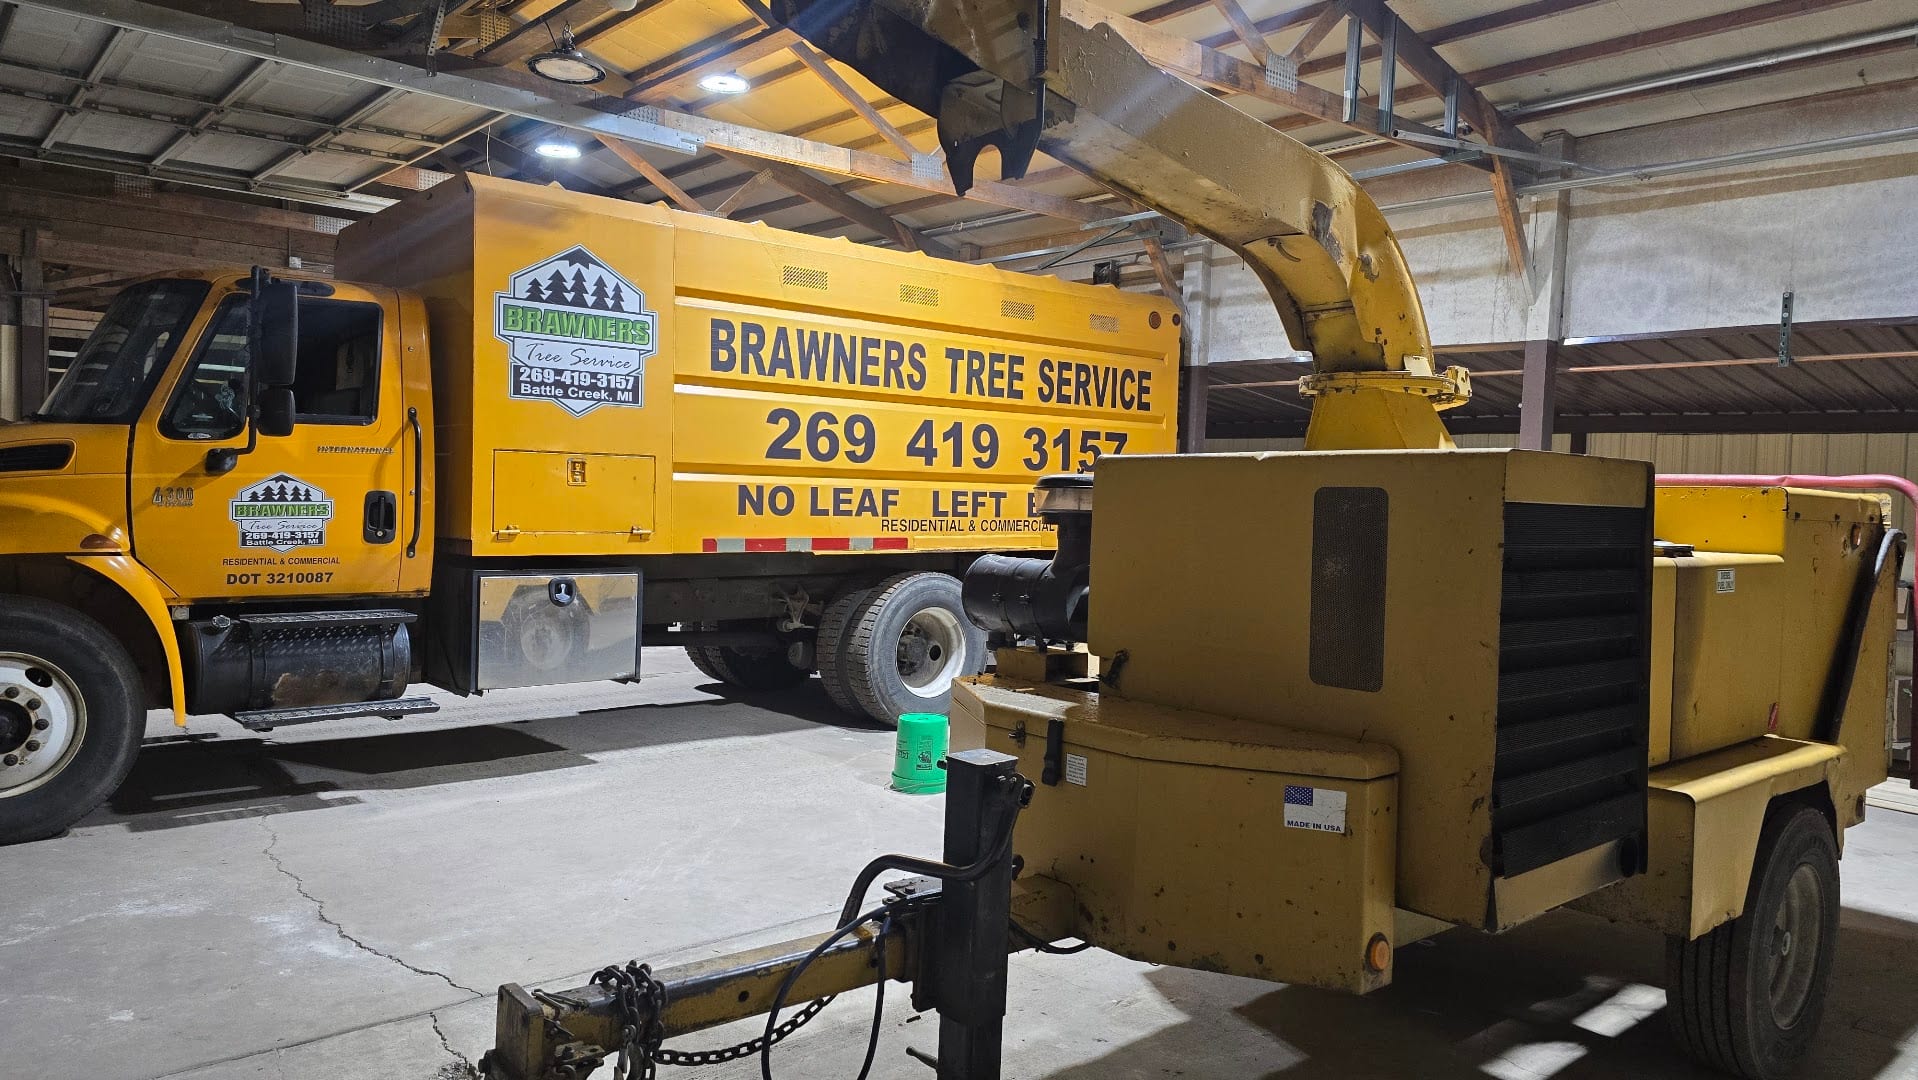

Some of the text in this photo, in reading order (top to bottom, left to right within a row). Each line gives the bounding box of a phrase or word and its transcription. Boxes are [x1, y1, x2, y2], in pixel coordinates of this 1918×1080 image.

[503, 304, 650, 346] BRAWNERS
[526, 343, 632, 369] Tree Service
[711, 318, 1152, 412] BRAWNERS TREE SERVICE
[519, 367, 634, 390] 269-419-3157
[520, 383, 633, 402] Battle Creek, MI
[765, 408, 876, 463] 269
[906, 419, 999, 470] 419
[317, 446, 393, 454] INTERNATIONAL
[152, 487, 194, 504] 4300
[738, 484, 795, 516] NO
[810, 487, 900, 517] LEAF
[932, 490, 1007, 518] LEFT
[235, 504, 329, 517] BRAWNERS
[249, 520, 318, 530] Tree Service
[881, 519, 1055, 532] RESIDENTIAL & COMMERCIAL
[245, 532, 320, 540] 269-419-3157
[222, 558, 277, 566] RESIDENTIAL
[288, 557, 340, 565] COMMERCIAL
[226, 572, 334, 585] DOT 3210087
[1287, 820, 1311, 829] MADE
[1324, 824, 1342, 832] USA
